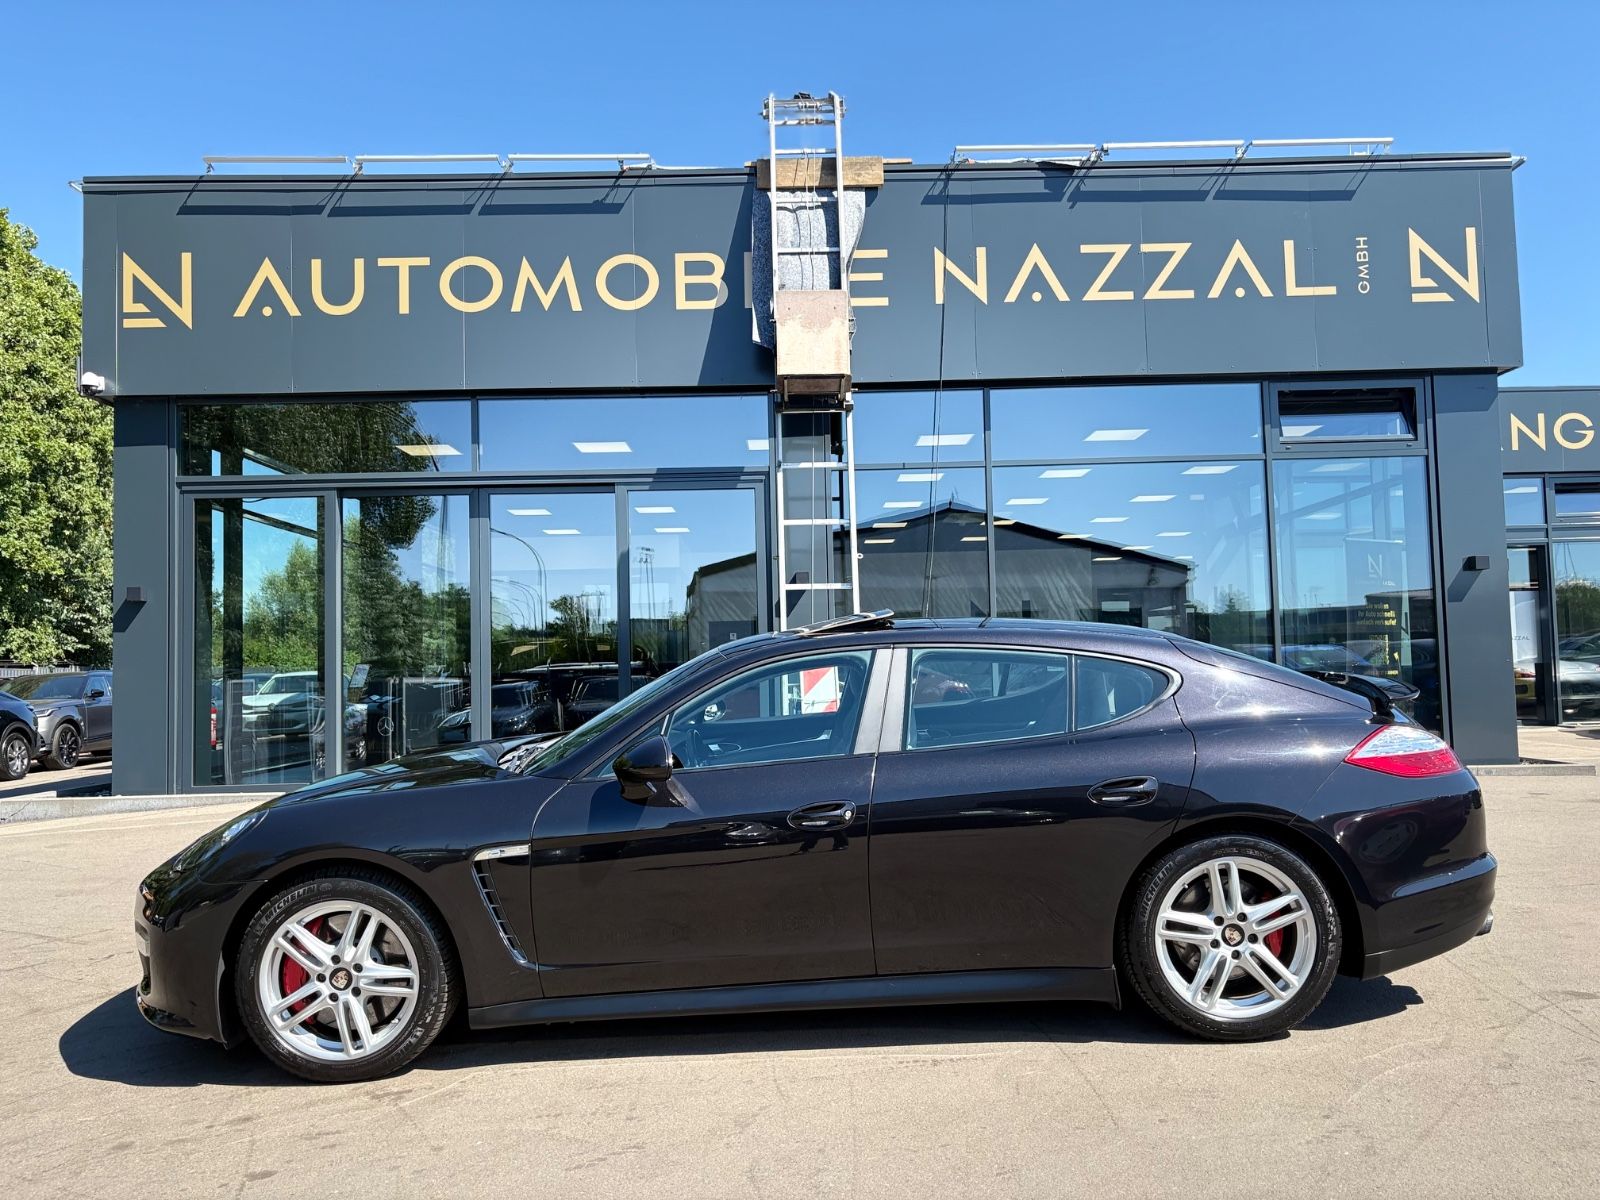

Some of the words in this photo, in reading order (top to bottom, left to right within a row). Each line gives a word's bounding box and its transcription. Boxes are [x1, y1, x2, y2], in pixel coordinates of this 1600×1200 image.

[233, 248, 890, 318] AUTOMOBIE
[934, 239, 1338, 305] NAZZAL
[1354, 236, 1371, 294] GMBH
[1501, 412, 1595, 451] NG
[264, 883, 318, 923] MICHELIN
[1141, 861, 1175, 919] MICHELIN
